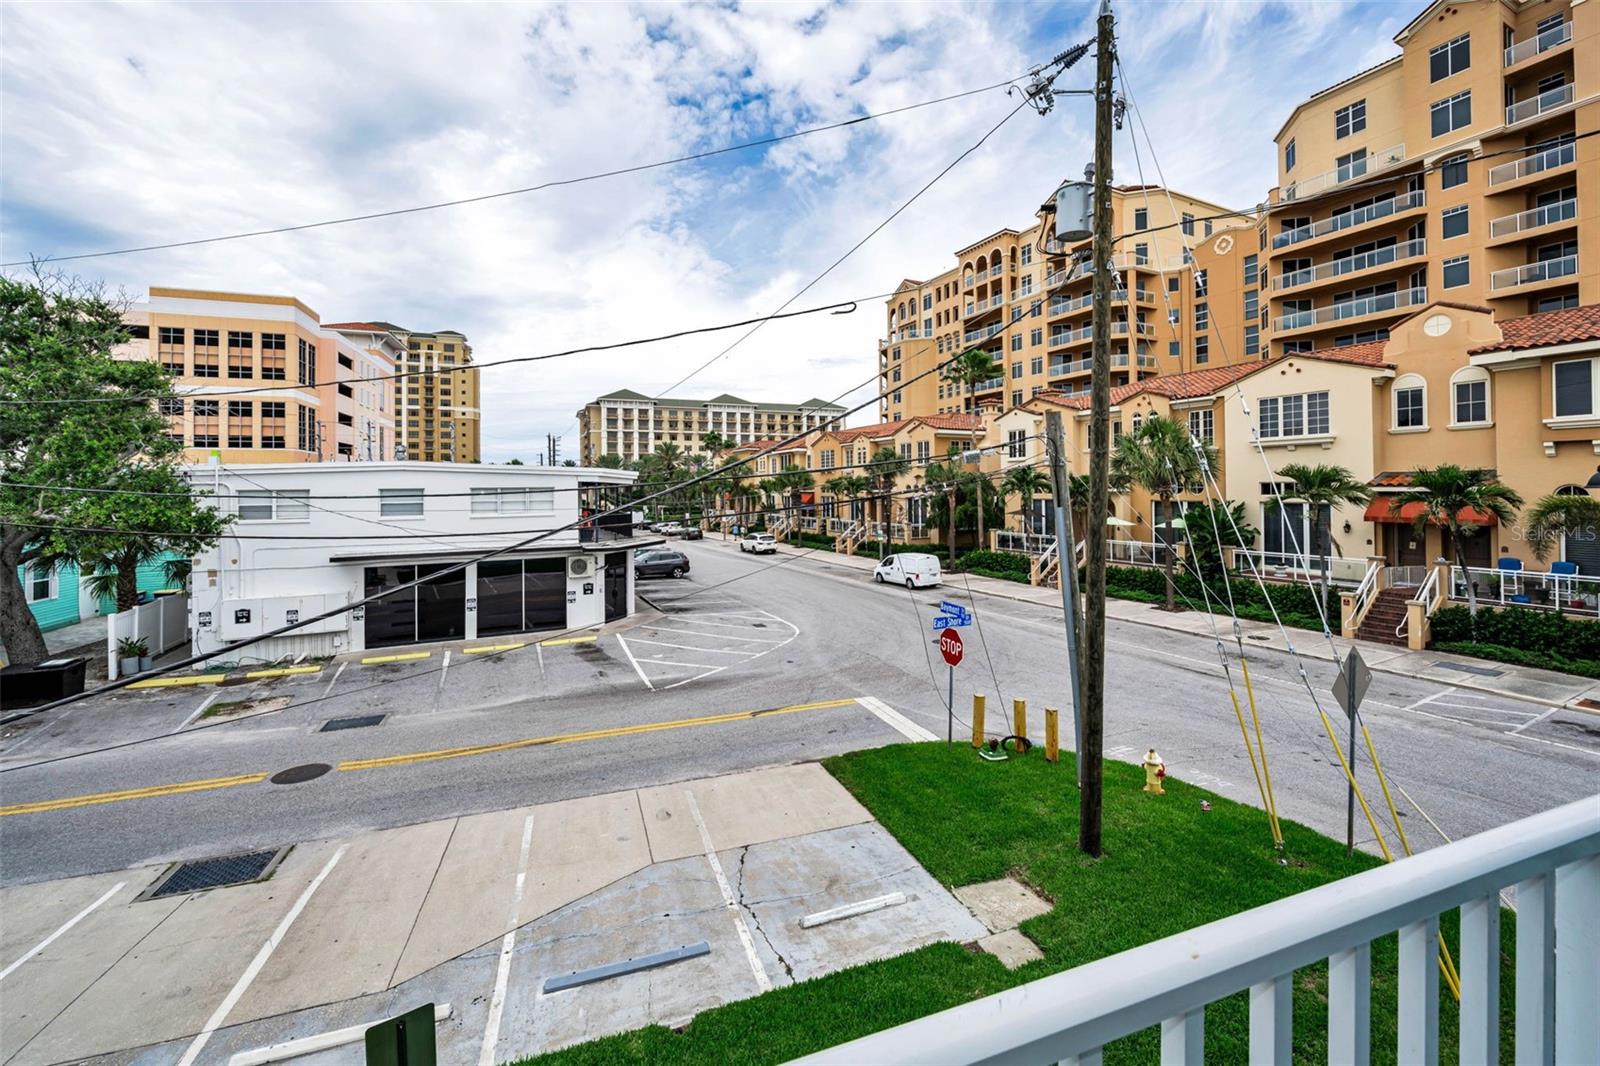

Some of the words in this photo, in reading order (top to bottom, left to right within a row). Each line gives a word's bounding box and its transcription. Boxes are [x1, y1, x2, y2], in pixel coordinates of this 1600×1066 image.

[933, 619, 946, 629] East
[947, 617, 962, 626] Shore
[941, 637, 962, 656] STOP
